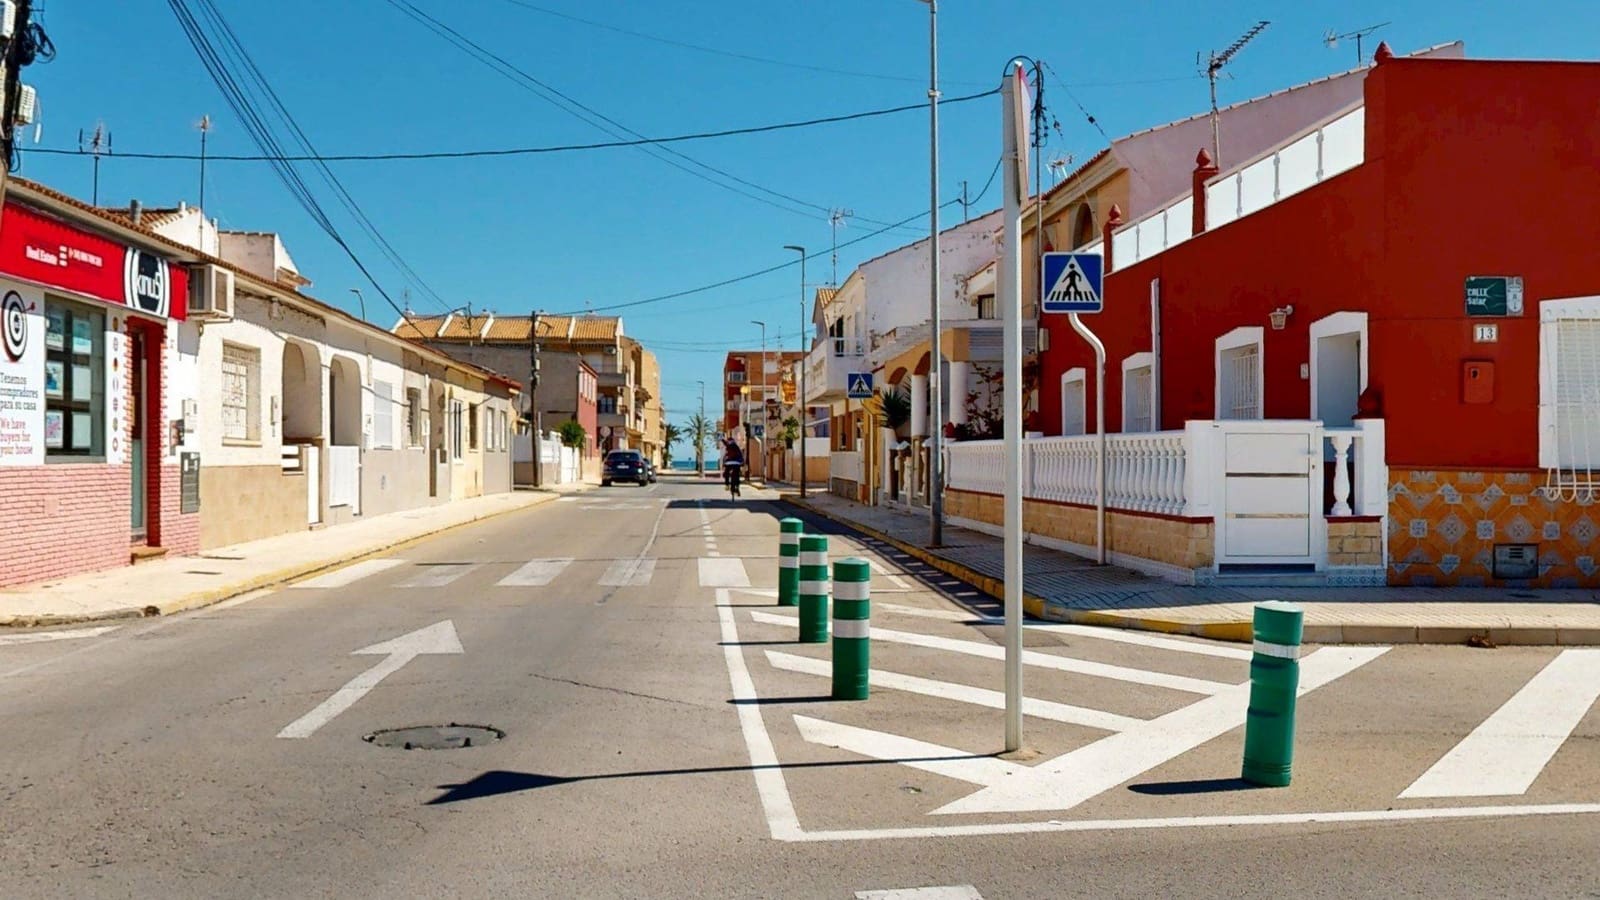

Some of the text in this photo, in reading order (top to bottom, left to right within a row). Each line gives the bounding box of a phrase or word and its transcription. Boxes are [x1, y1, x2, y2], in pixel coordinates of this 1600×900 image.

[1480, 327, 1493, 340] 13
[23, 402, 36, 411] casa
[12, 418, 26, 430] have
[15, 443, 33, 455] house
